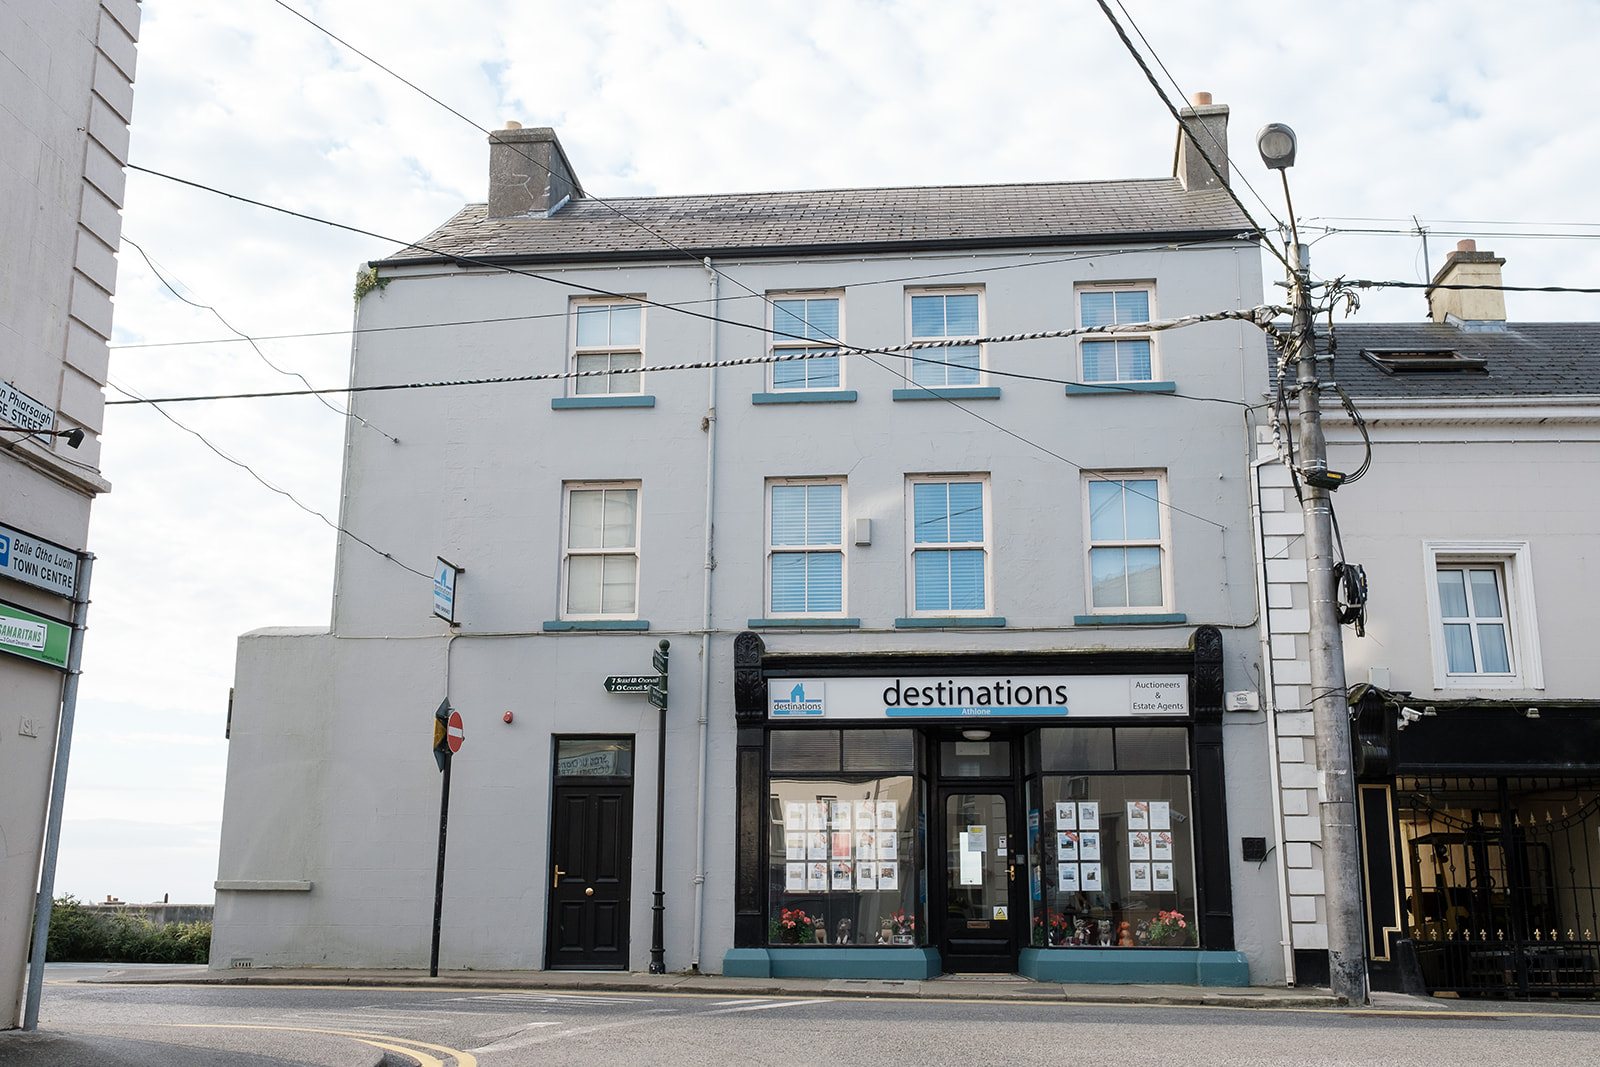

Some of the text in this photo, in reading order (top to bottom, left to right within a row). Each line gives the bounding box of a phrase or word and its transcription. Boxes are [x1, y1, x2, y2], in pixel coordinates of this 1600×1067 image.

[11, 408, 43, 430] STREET
[13, 538, 33, 555] Baile
[54, 553, 73, 571] Luain
[13, 557, 73, 588] TOWN CENTRE
[1135, 681, 1181, 689] Auctioneers
[882, 678, 1068, 707] destinations
[1154, 691, 1162, 699] &
[773, 702, 822, 711] destinations
[962, 707, 991, 715] Athlone
[1132, 702, 1184, 712] Estate Agents
